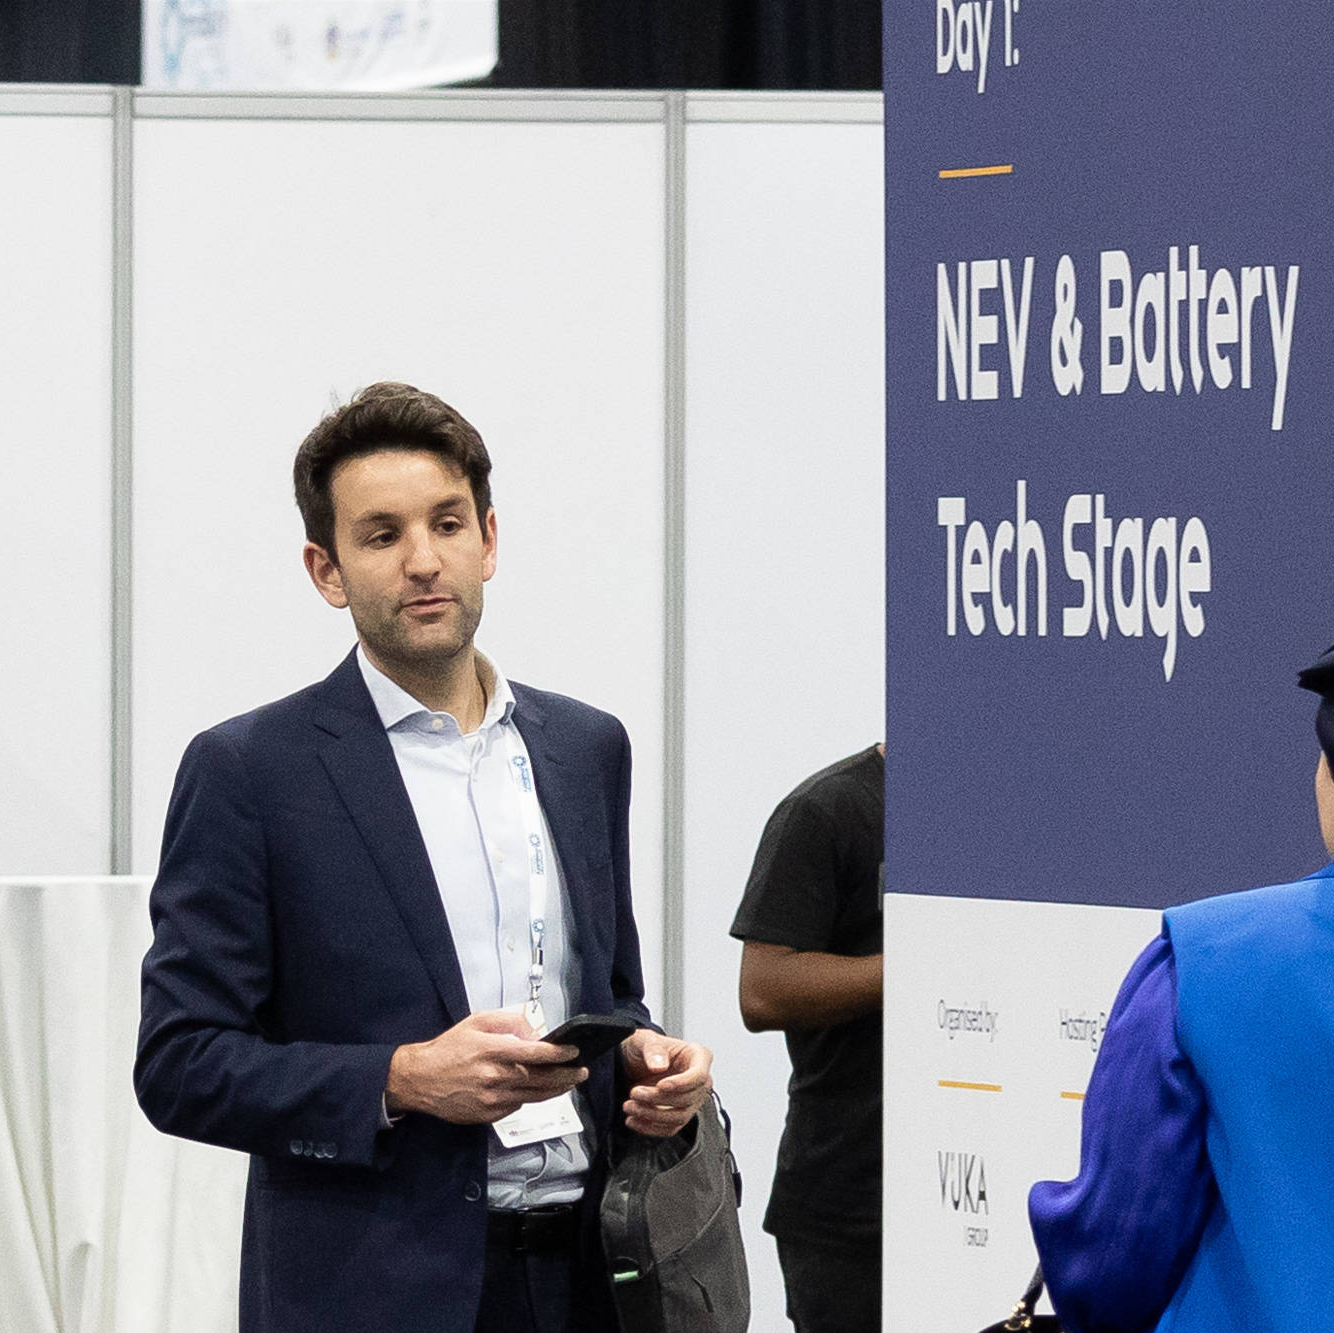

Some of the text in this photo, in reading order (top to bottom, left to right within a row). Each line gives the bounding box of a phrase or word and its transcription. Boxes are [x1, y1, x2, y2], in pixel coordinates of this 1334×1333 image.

[936, 0, 1020, 94] Day 1:
[937, 244, 1300, 431] NEV & Battery
[937, 479, 1211, 682] Tech Stage
[1059, 1008, 1097, 1052] Hosting
[938, 1150, 989, 1216] VUKA
